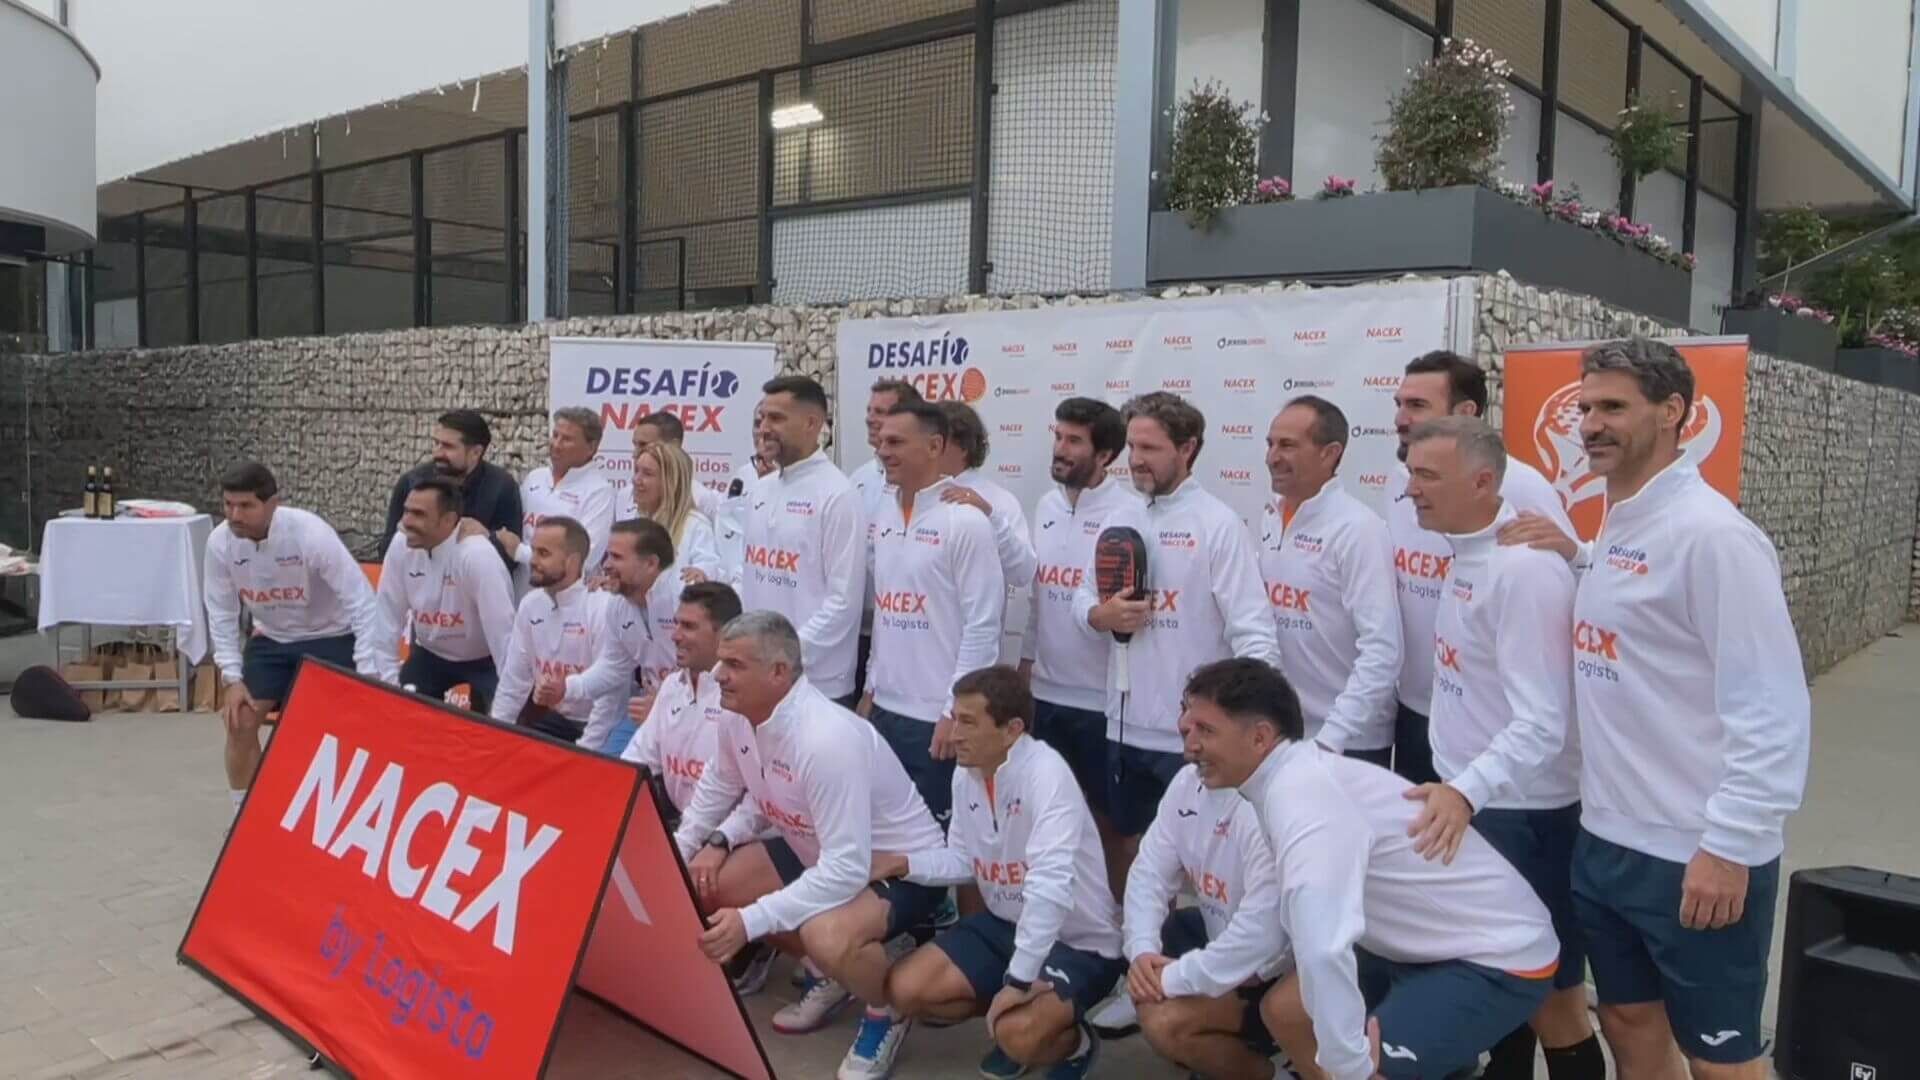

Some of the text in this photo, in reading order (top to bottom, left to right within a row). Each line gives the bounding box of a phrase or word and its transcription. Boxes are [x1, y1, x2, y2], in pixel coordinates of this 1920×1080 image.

[1163, 336, 1192, 345] NACEX
[1294, 331, 1326, 340] NACEX
[1366, 328, 1402, 337] NACEX
[878, 373, 958, 401] CEX
[1224, 379, 1256, 388] NACEX
[1363, 377, 1401, 386] NACEX
[1222, 424, 1252, 434] NACEX
[1220, 471, 1250, 480] NACEX
[745, 544, 800, 573] NACEX
[1395, 548, 1452, 581] ACEX
[1036, 564, 1083, 588] NACE
[240, 587, 305, 602] NACEX
[1264, 582, 1311, 612] CEX
[1578, 660, 1618, 682] ogista
[281, 733, 562, 956] NACEX
[320, 903, 364, 979] by
